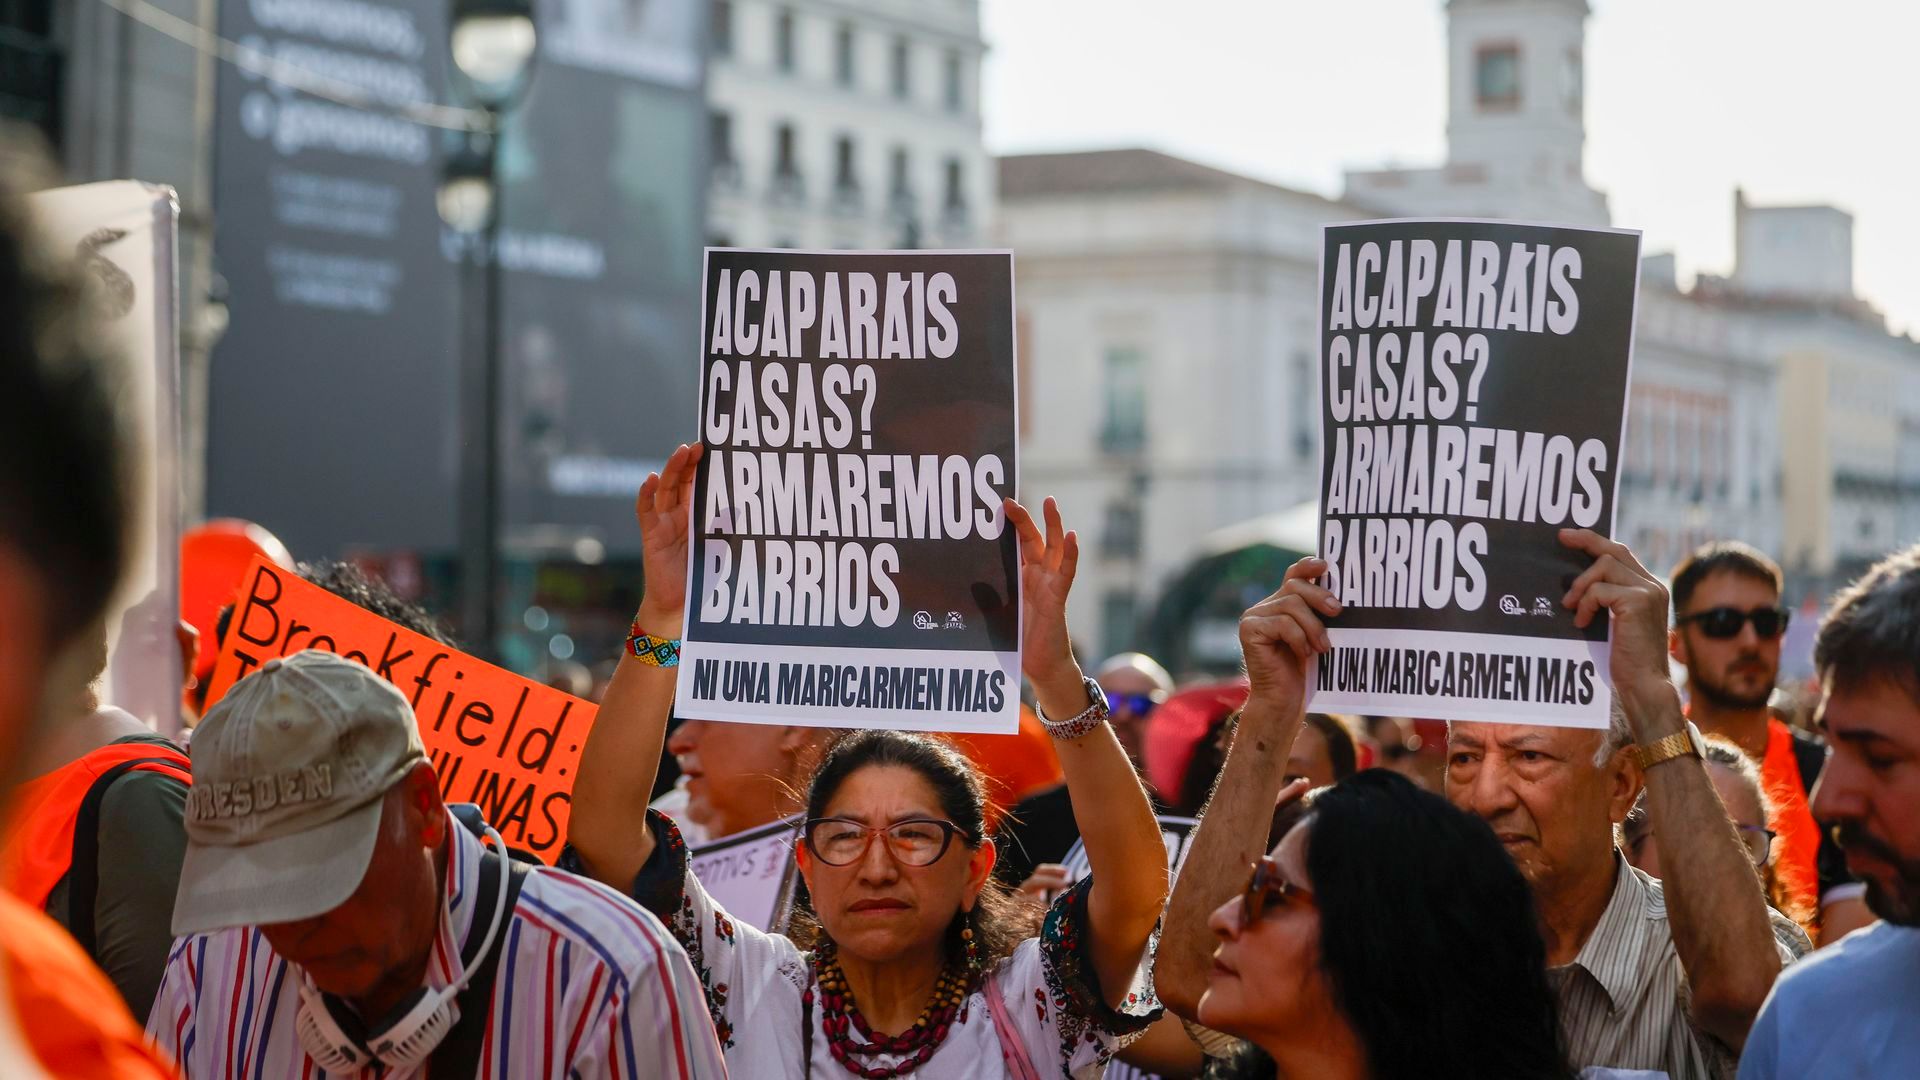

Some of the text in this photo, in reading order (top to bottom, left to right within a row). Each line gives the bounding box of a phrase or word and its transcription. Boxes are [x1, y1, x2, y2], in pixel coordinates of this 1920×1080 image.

[706, 359, 877, 449] CASAS?
[1329, 332, 1489, 422] CASAS?
[704, 451, 1004, 541] ARMAREMOS
[1326, 425, 1607, 528] ARMAREMOS
[700, 539, 900, 628] BARRIOS
[1320, 518, 1488, 612] BARRIOS
[238, 566, 577, 776] Brkfield:
[693, 659, 1006, 713] NI UNA MARICARMEN MÁS
[1317, 647, 1595, 706] NI UNA MARICARMEN MÁS
